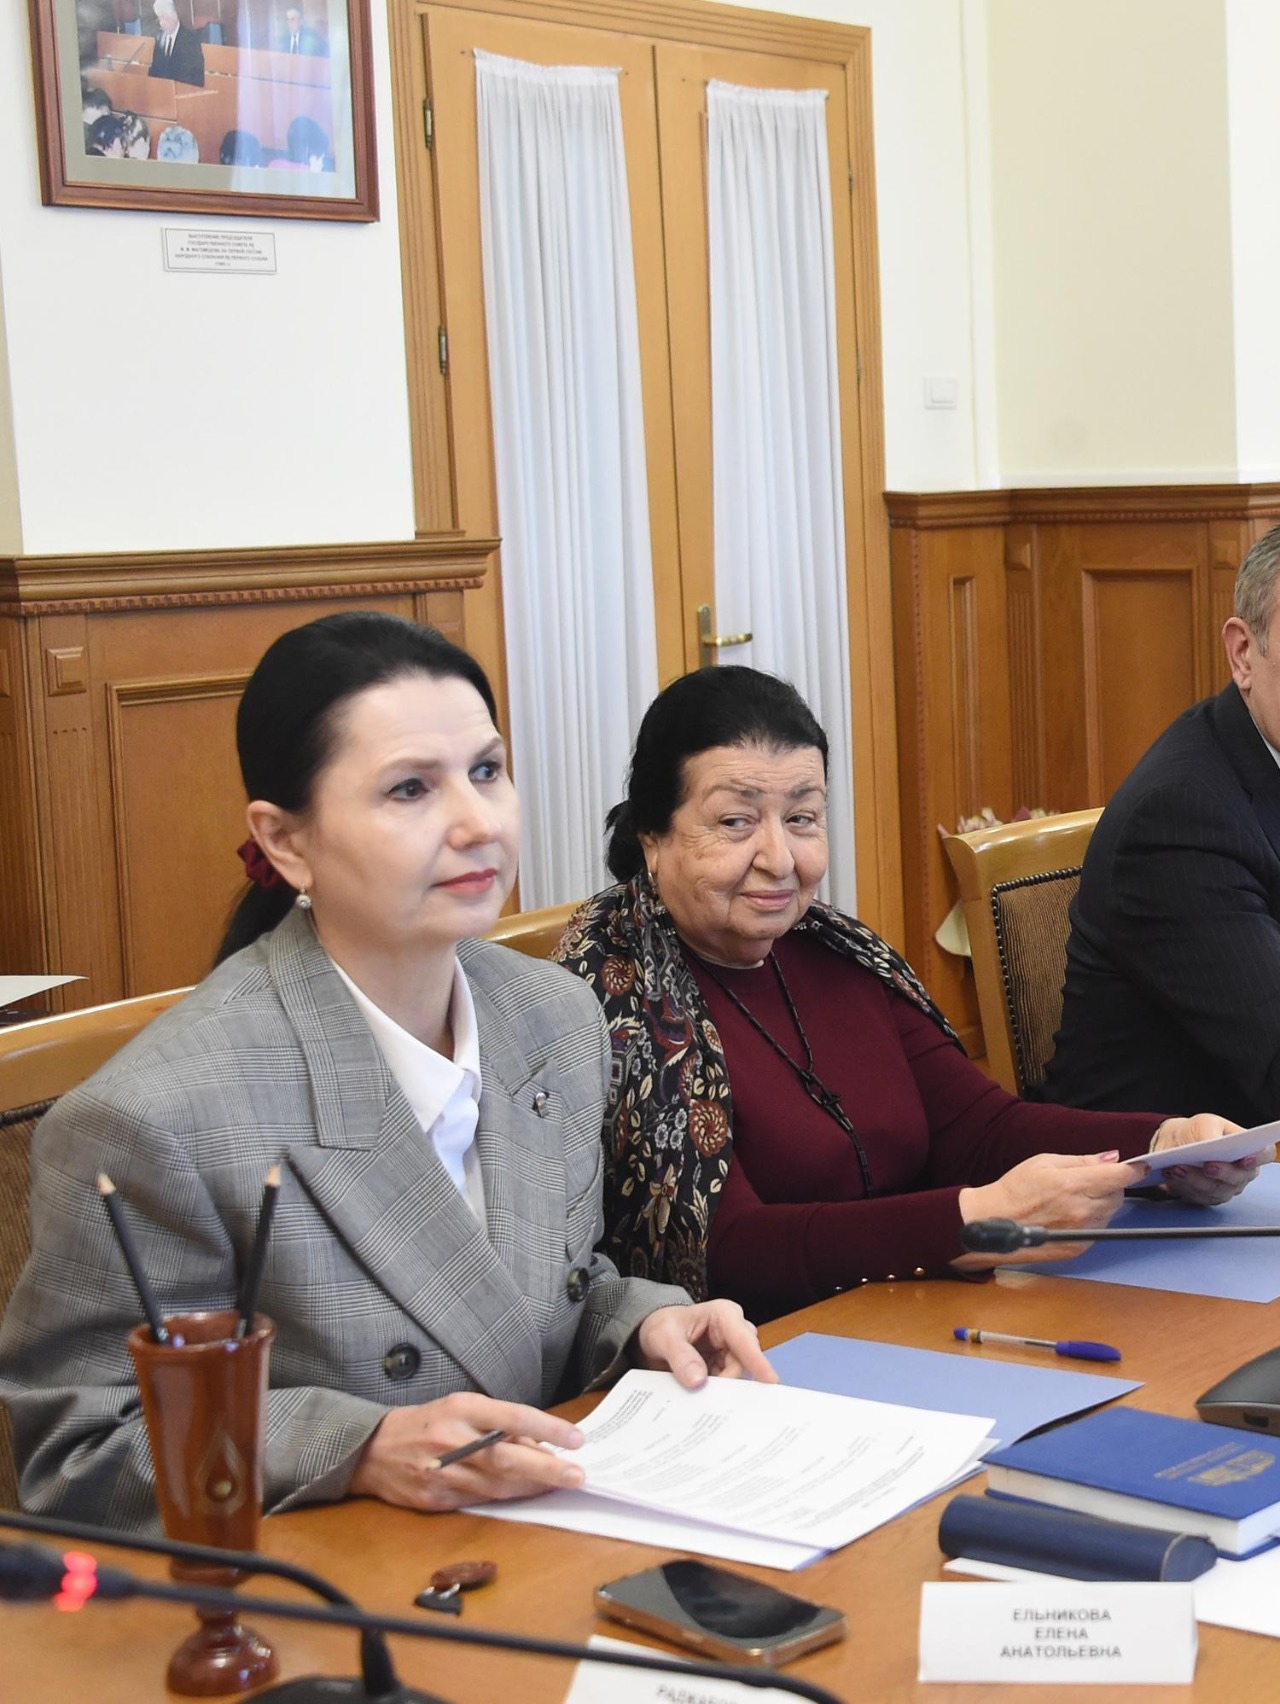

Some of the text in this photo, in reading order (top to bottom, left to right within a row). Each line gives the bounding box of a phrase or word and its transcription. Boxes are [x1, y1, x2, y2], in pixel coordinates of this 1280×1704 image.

[1012, 1608, 1112, 1622] ЕЛЬНИКОВА
[1034, 1627, 1089, 1640] ЕЛЕНА
[1000, 1645, 1122, 1658] АНАТОЛЬЕВНА
